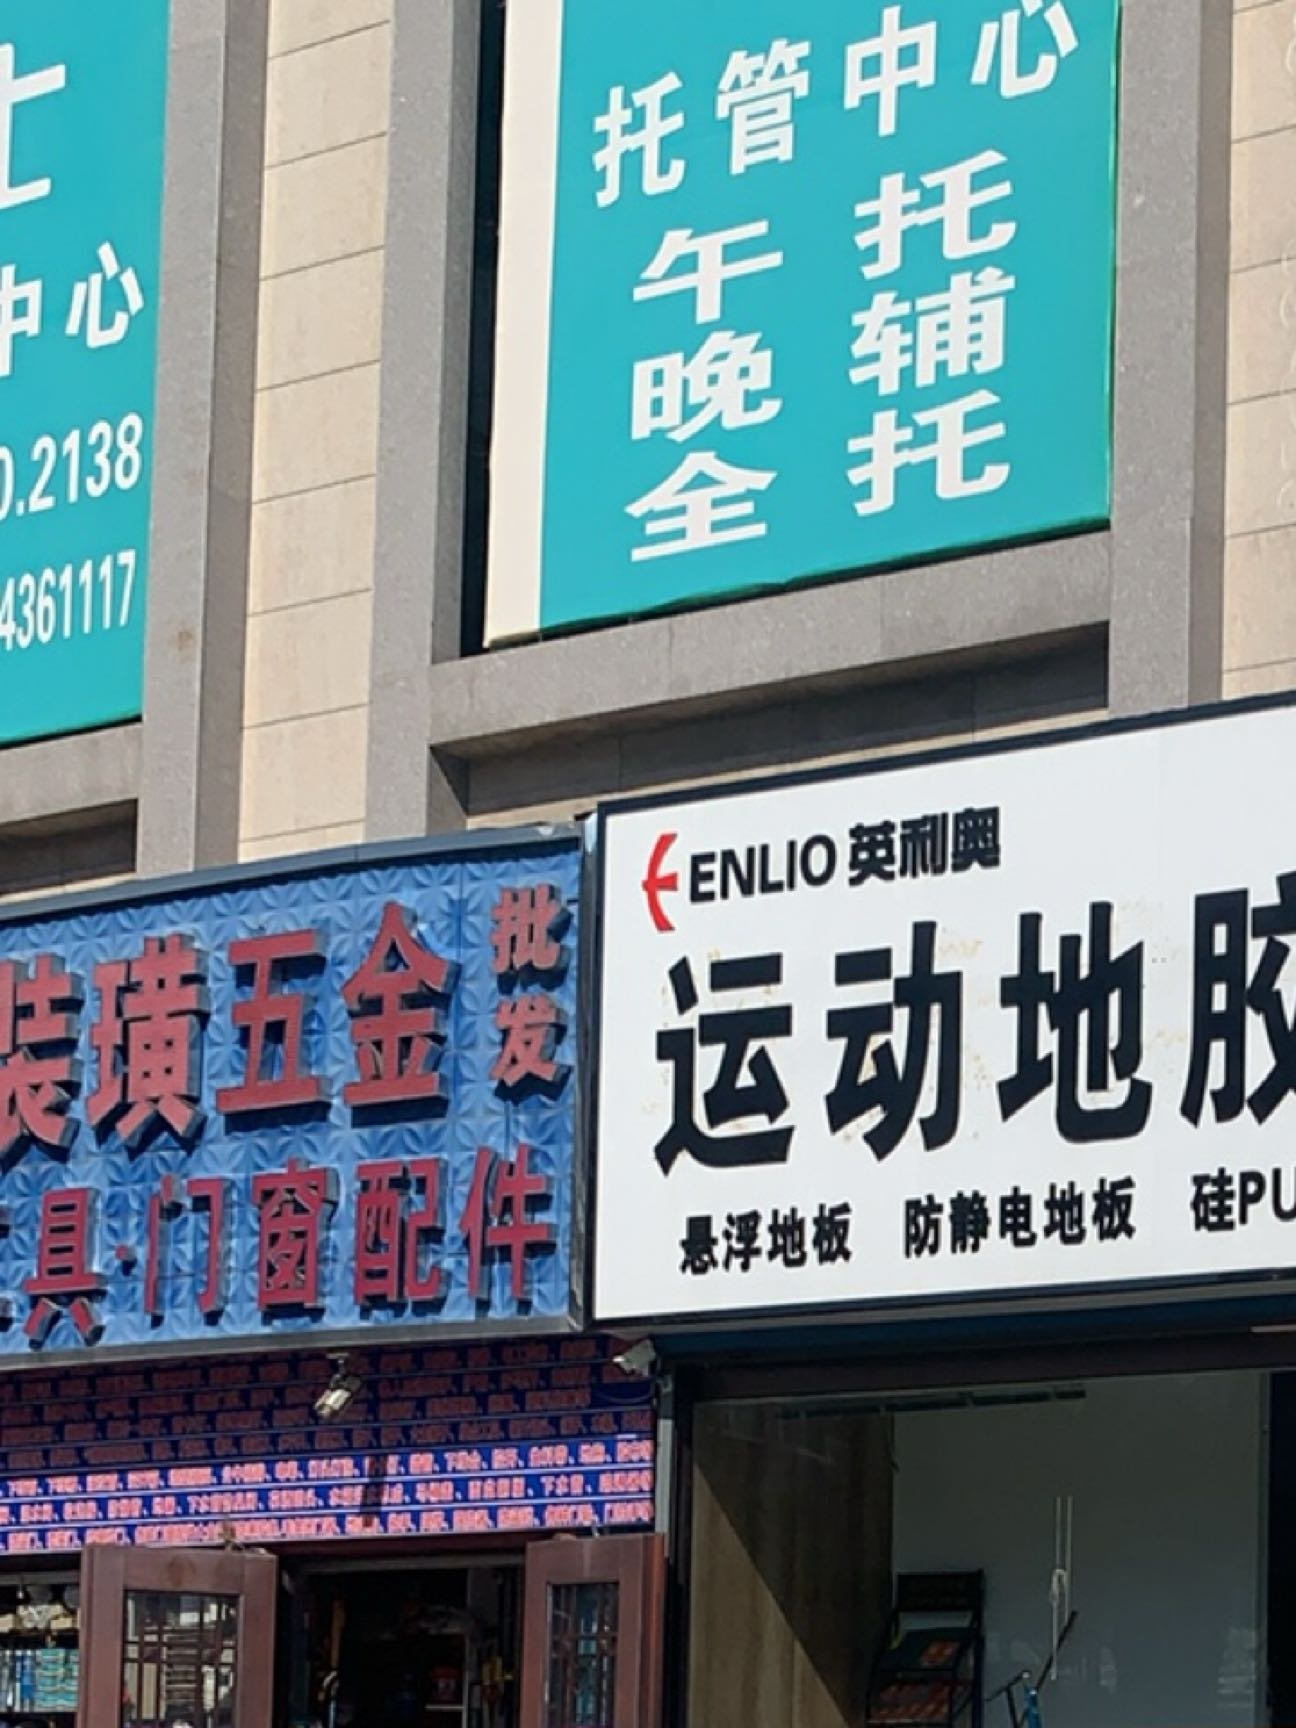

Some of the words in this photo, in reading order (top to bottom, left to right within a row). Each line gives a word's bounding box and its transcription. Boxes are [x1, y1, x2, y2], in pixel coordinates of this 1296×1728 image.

[592, 0, 1080, 208] 托管中心
[690, 832, 837, 904] ENLIO
[849, 806, 1001, 885] 英利奥
[490, 884, 568, 1088] 批发
[680, 1203, 852, 1276] 悬浮地板
[904, 1176, 1137, 1259] 防静电地板
